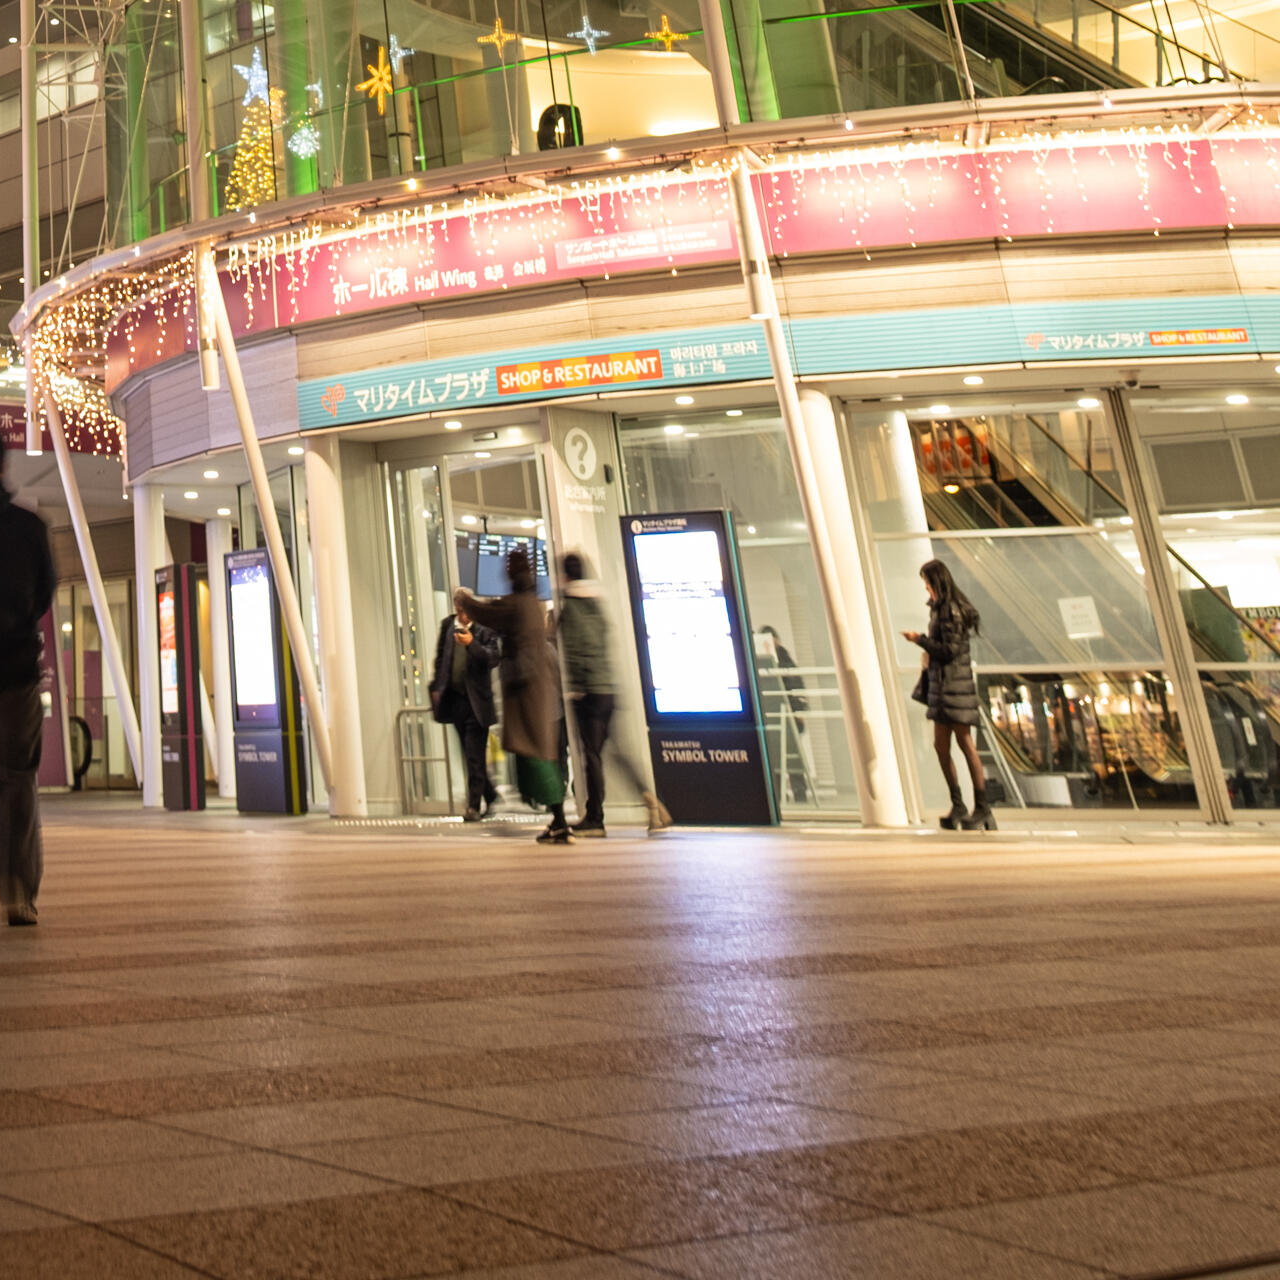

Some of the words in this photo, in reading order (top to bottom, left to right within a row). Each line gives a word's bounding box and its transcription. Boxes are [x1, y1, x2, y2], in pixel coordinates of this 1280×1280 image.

[414, 270, 439, 292] Hall
[440, 268, 477, 289] Wing
[1047, 331, 1145, 351] マリタイムプラザ
[500, 368, 541, 389] SHOP
[543, 368, 553, 383] &
[554, 356, 658, 383] RESTAURANT
[353, 368, 490, 413] マリタイムプラザ
[662, 749, 708, 763] SYMBOL
[707, 749, 749, 763] TOWER
